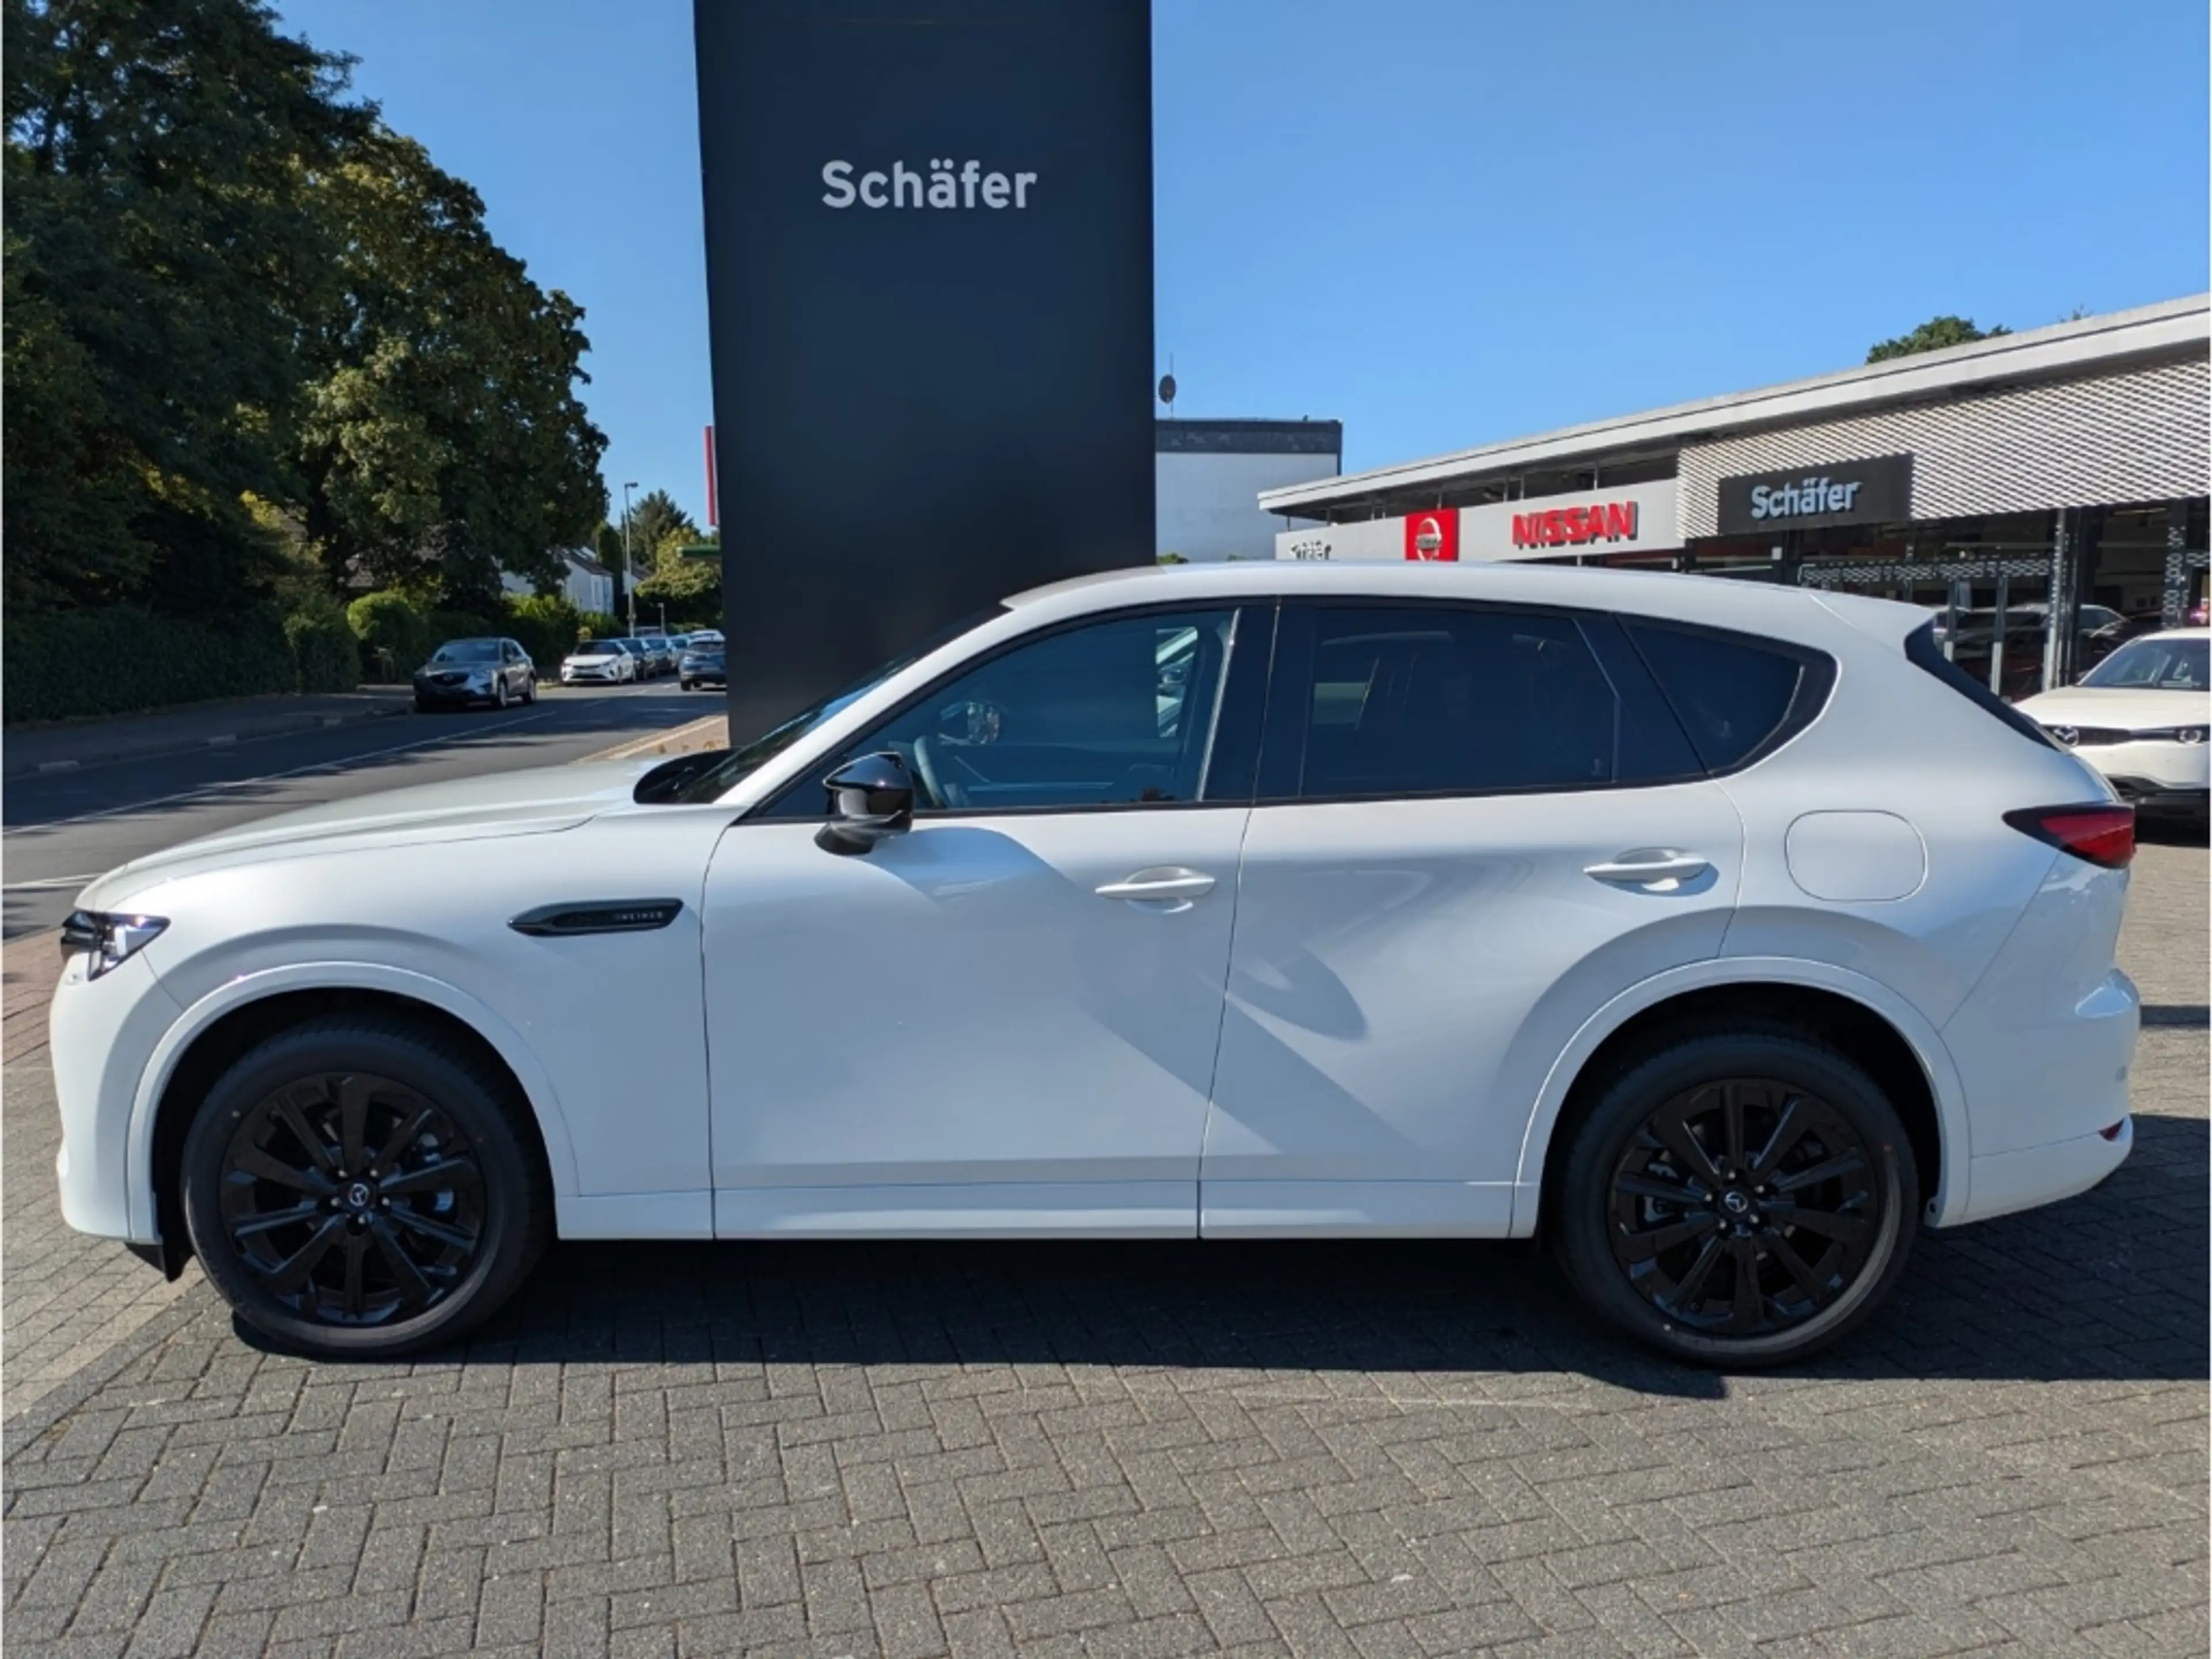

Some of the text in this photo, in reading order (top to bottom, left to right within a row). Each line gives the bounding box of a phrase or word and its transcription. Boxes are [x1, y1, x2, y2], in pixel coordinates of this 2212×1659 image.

[822, 158, 1037, 208] Schäfer
[1751, 478, 1863, 518] Schäfer
[1512, 501, 1638, 547] NISSAN
